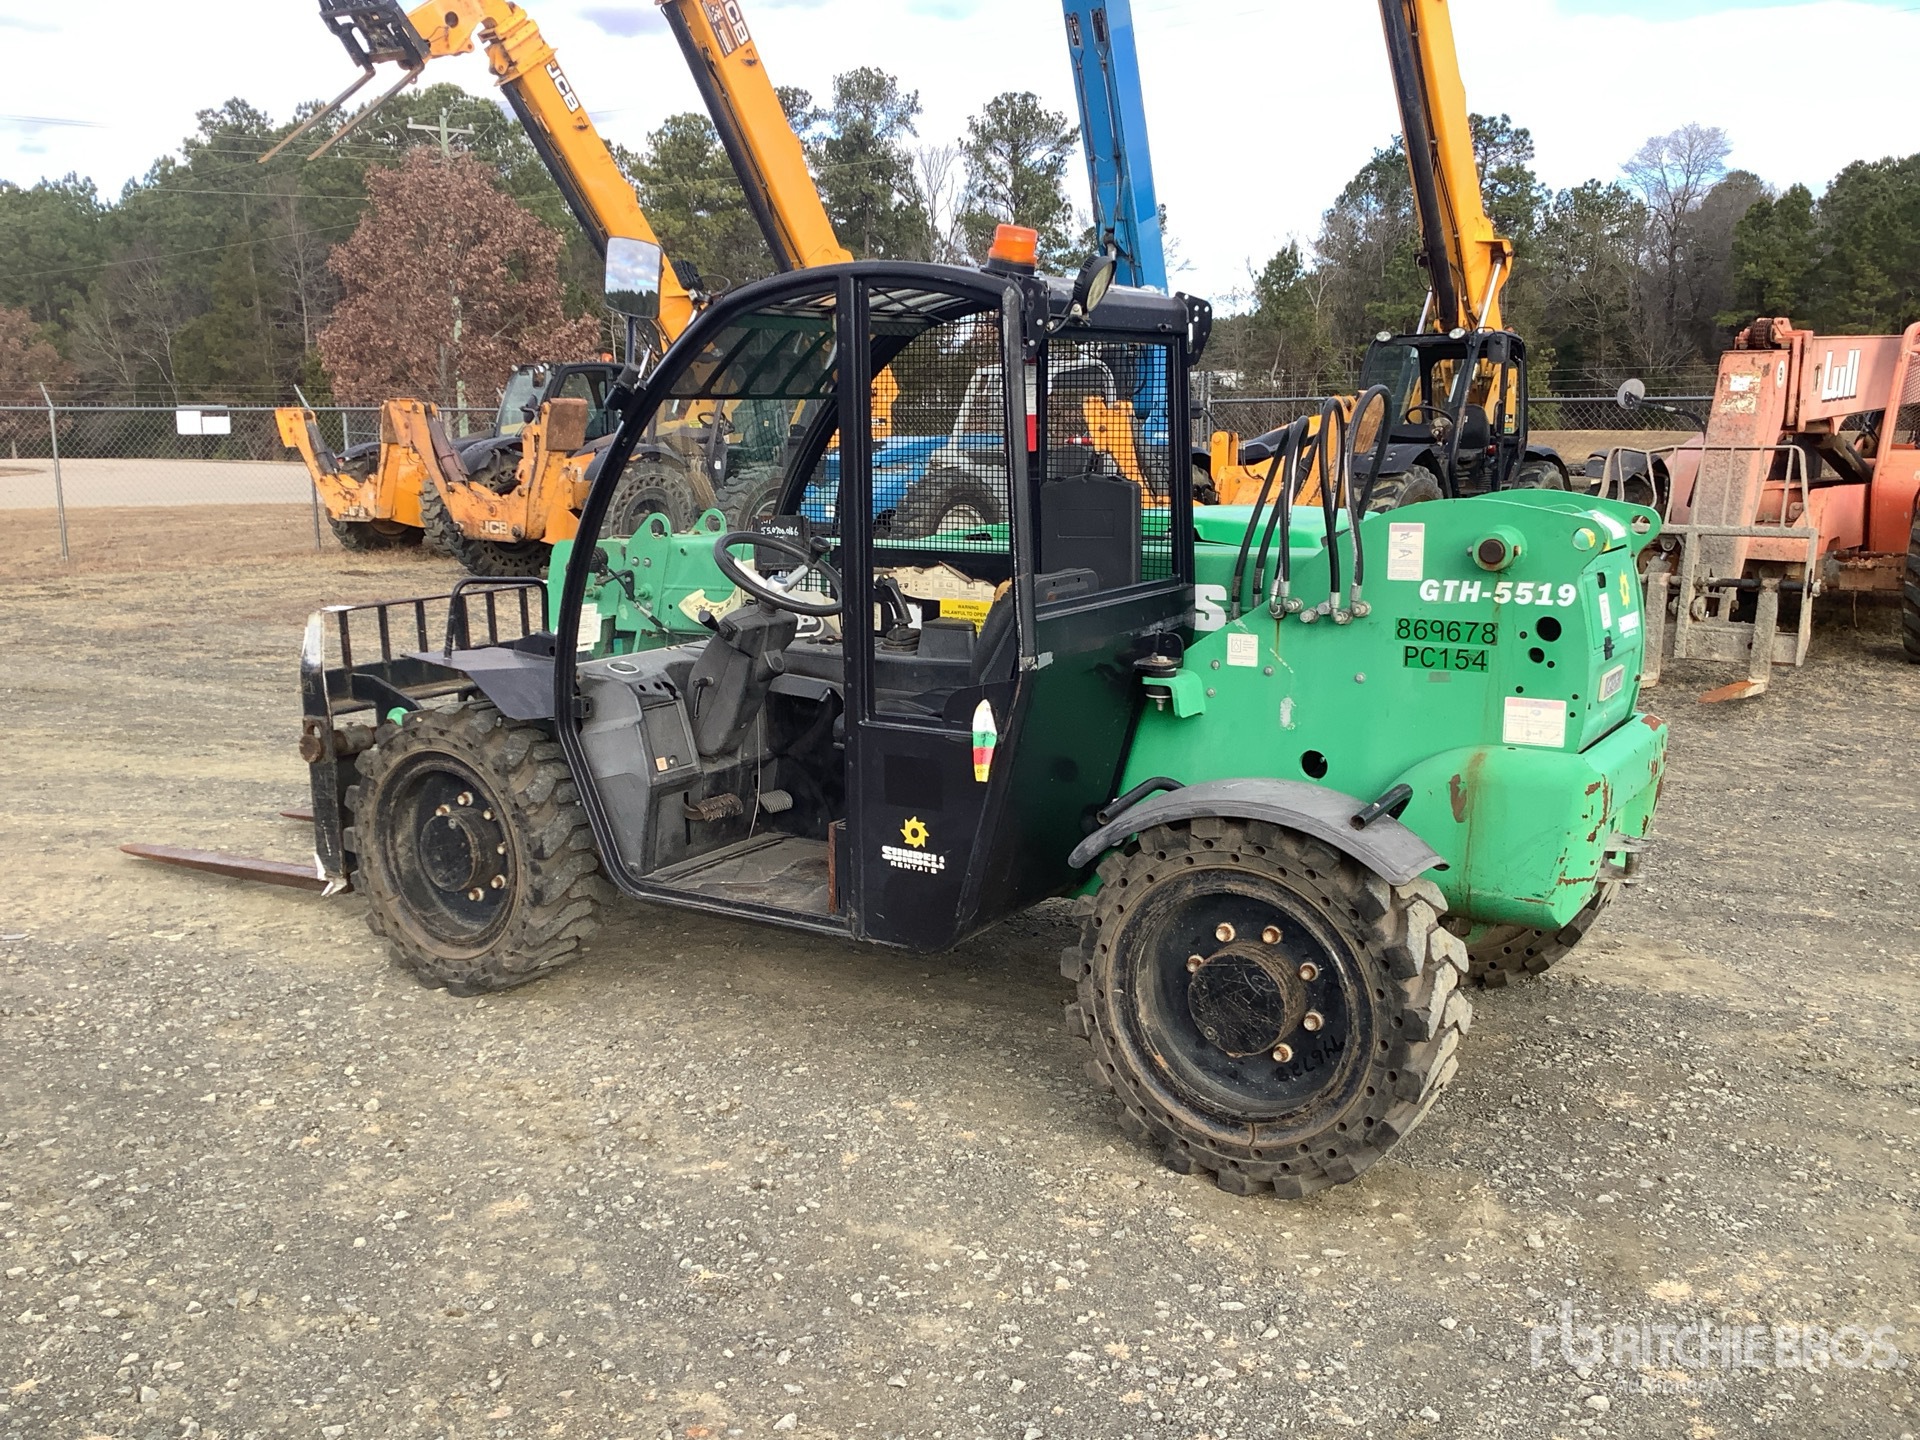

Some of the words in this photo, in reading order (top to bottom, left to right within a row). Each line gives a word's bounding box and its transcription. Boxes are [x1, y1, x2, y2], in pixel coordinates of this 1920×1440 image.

[722, 0, 750, 45] CB
[546, 62, 580, 112] JCB
[480, 519, 508, 534] JCB
[1419, 579, 1577, 607] GTH-5519
[1396, 618, 1497, 645] 869678
[1404, 645, 1488, 671] PC154
